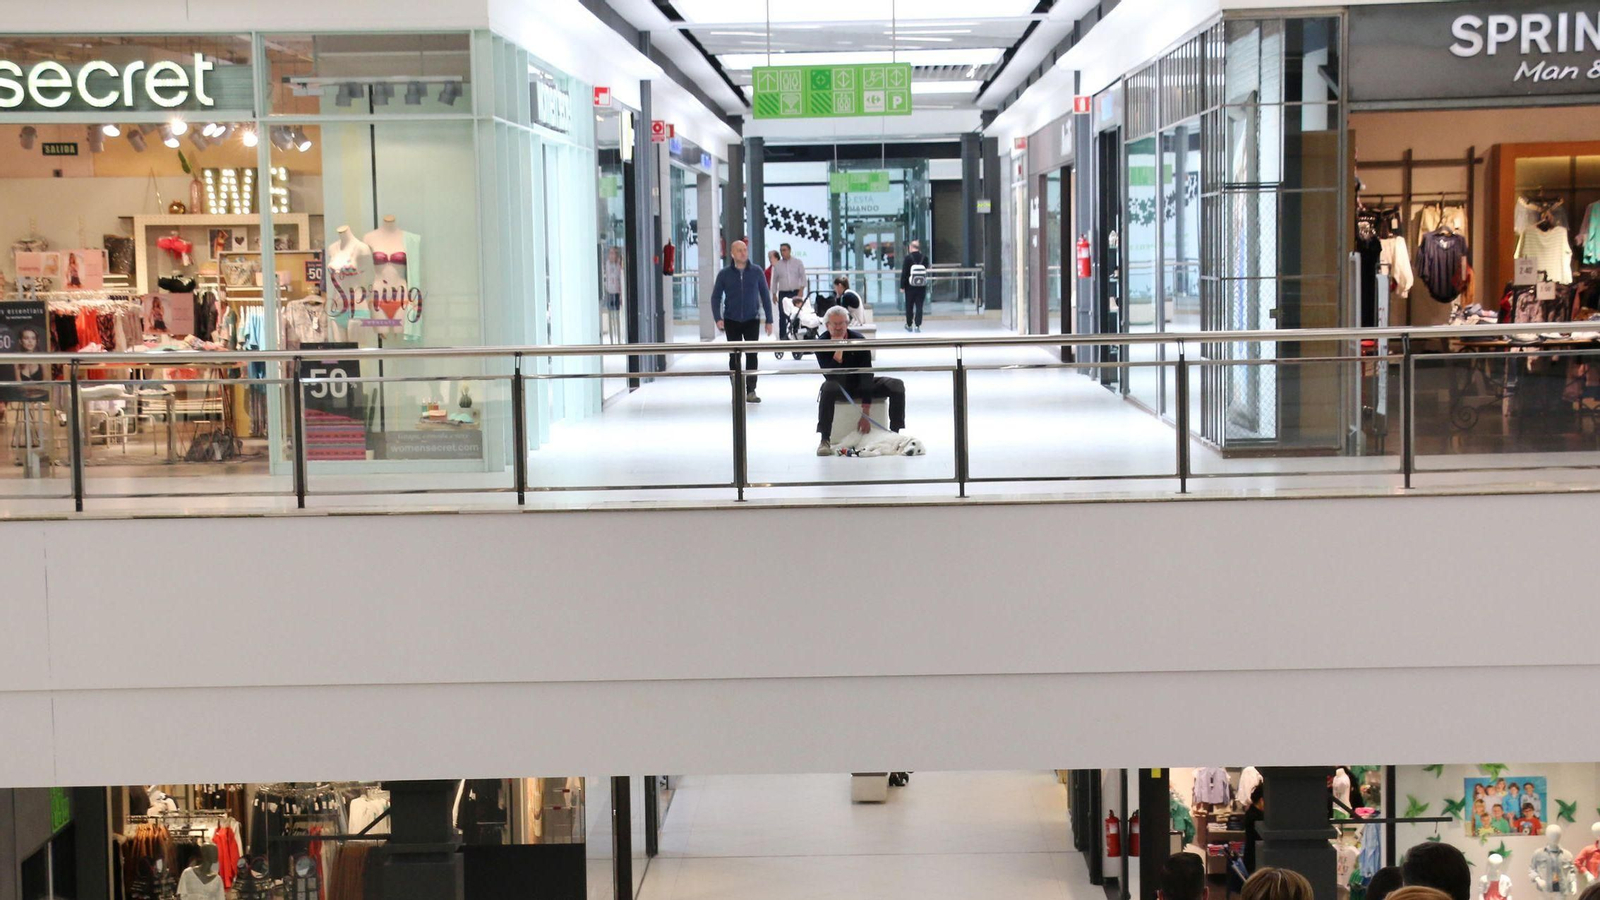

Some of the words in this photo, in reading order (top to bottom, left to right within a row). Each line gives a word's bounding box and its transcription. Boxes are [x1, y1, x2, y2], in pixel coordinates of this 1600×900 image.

[0, 53, 214, 107] secret
[1513, 60, 1579, 82] Man
[892, 95, 903, 109] P
[45, 145, 75, 153] SALIDA
[326, 269, 424, 323] Spring
[390, 442, 479, 453] womensecret.com
